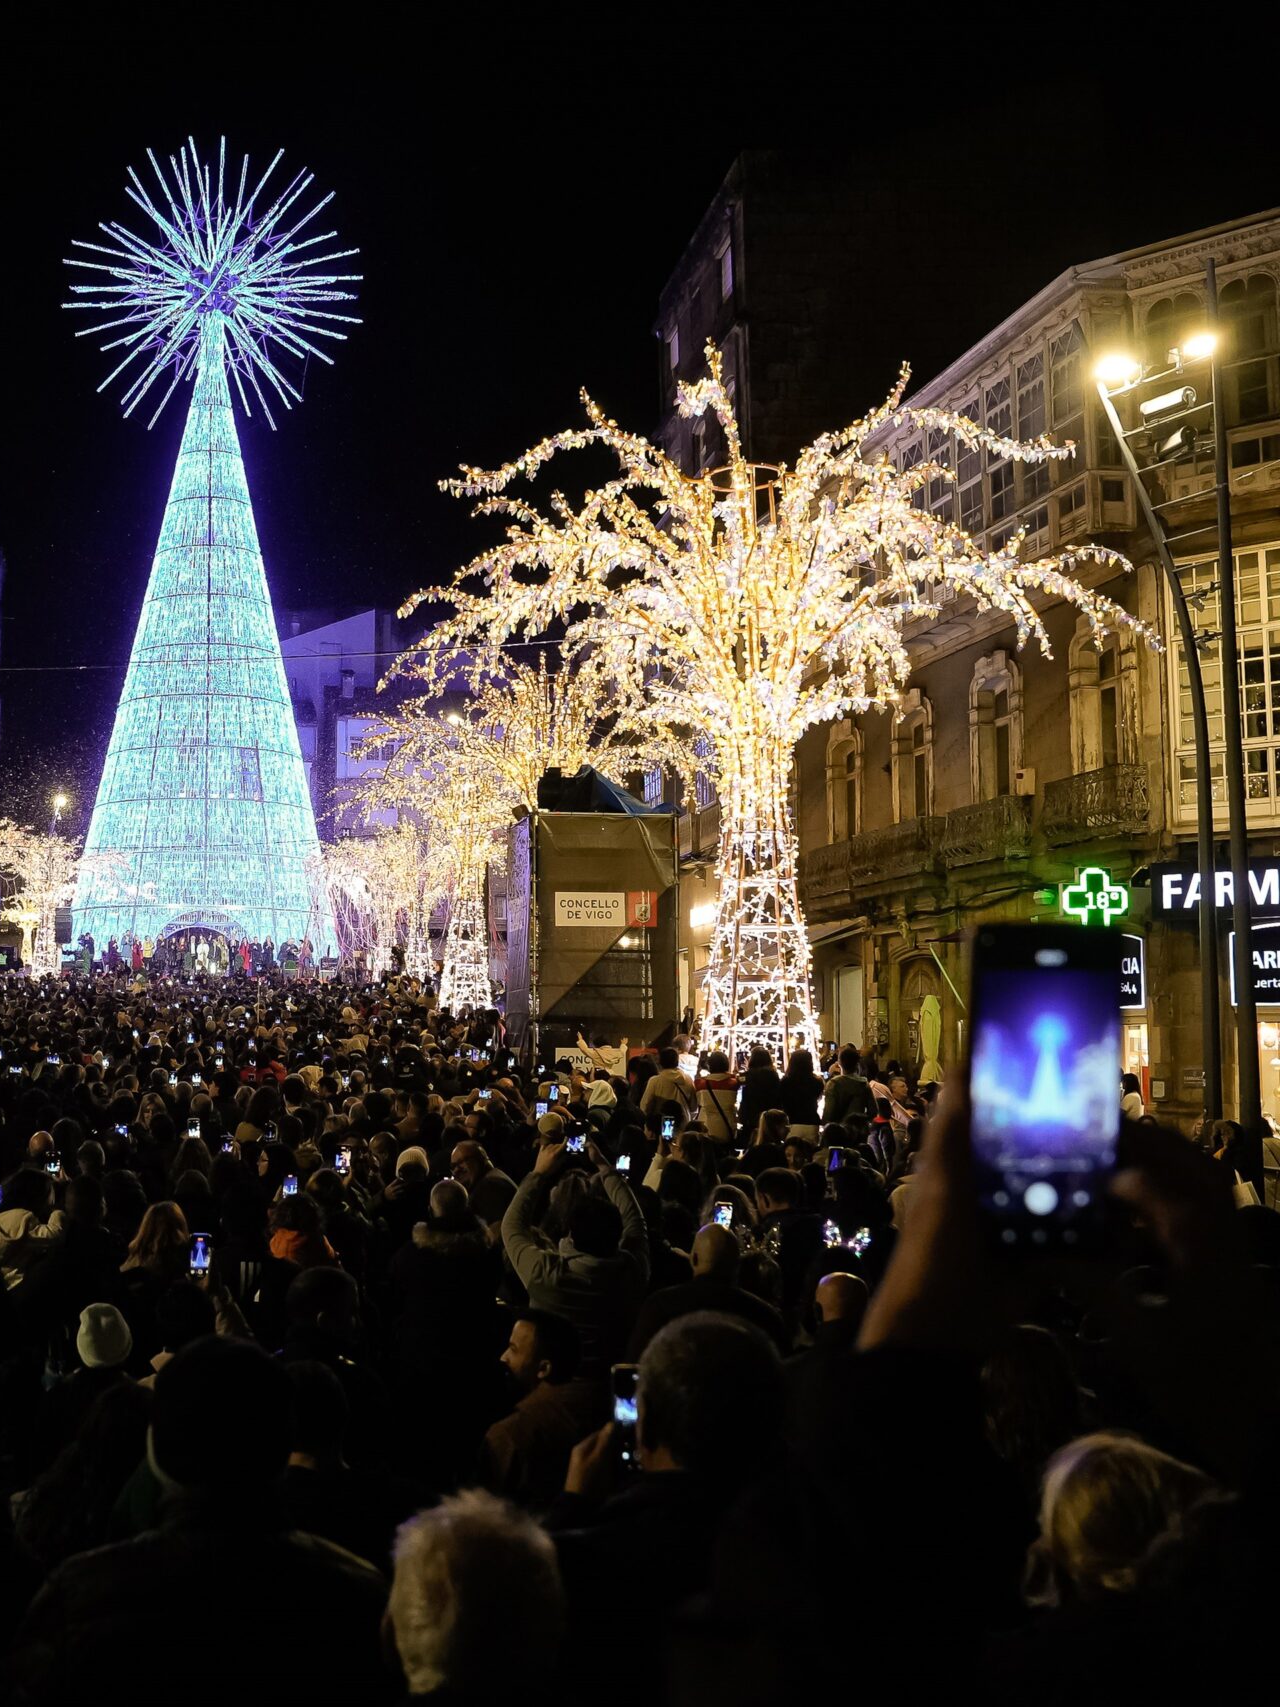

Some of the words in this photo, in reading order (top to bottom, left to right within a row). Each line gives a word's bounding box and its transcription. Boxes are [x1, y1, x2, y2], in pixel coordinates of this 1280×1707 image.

[560, 900, 619, 909] CONCELLO
[567, 911, 582, 919] DE
[586, 911, 613, 919] VIGO
[1122, 957, 1140, 974] CIA
[1252, 950, 1280, 969] AR
